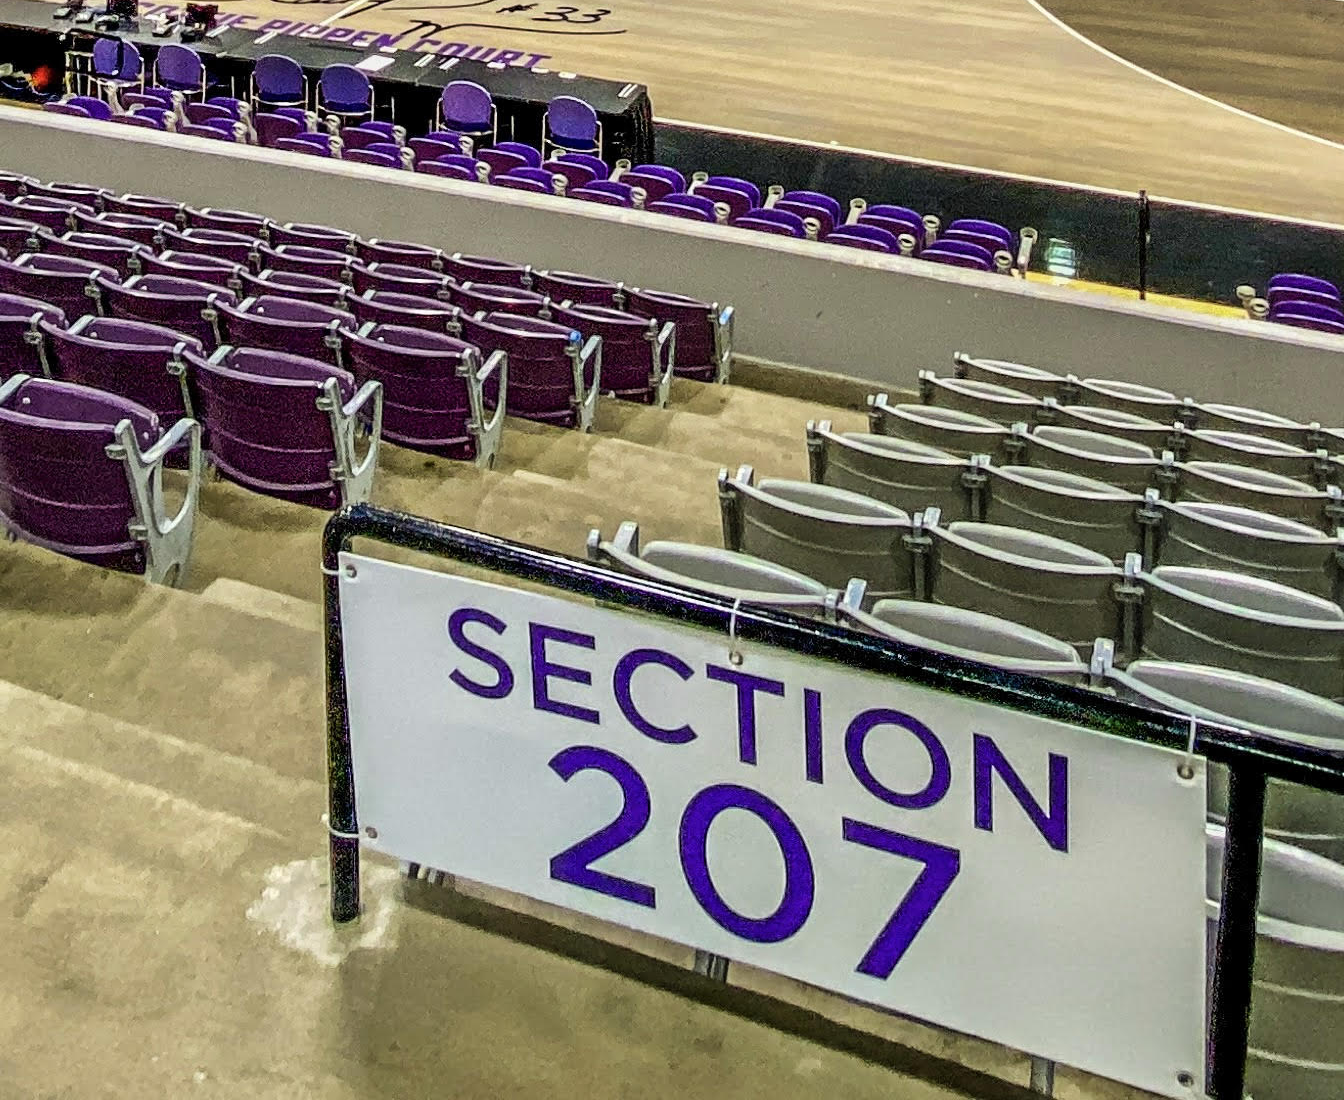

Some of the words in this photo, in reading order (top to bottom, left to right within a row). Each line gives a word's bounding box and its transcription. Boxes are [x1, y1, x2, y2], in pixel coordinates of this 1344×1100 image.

[408, 38, 553, 68] COURT
[446, 606, 1069, 854] SECTION
[548, 744, 961, 980] 207
